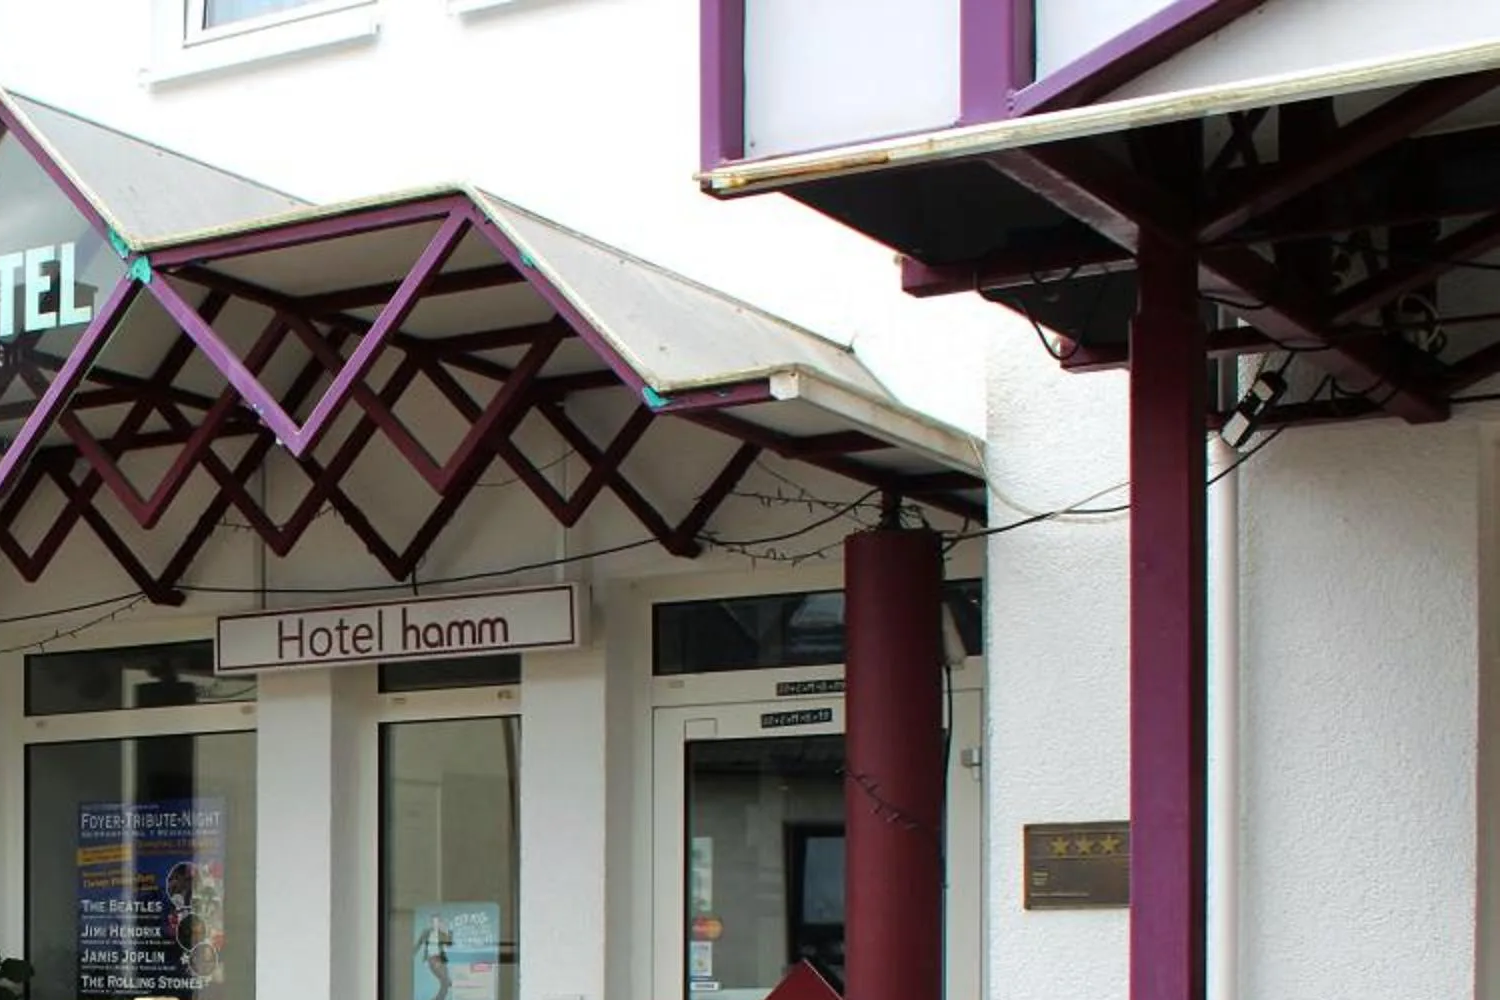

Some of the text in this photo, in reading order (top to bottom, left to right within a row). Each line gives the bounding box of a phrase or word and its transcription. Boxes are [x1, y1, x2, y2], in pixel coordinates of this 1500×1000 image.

[277, 607, 509, 659] Hotel hamm
[81, 900, 163, 913] THE BEATLES
[109, 924, 161, 937] HENDRIX
[81, 948, 165, 963] JANIS JOPLIN
[81, 975, 104, 988] THE
[107, 975, 156, 988] ROLLING
